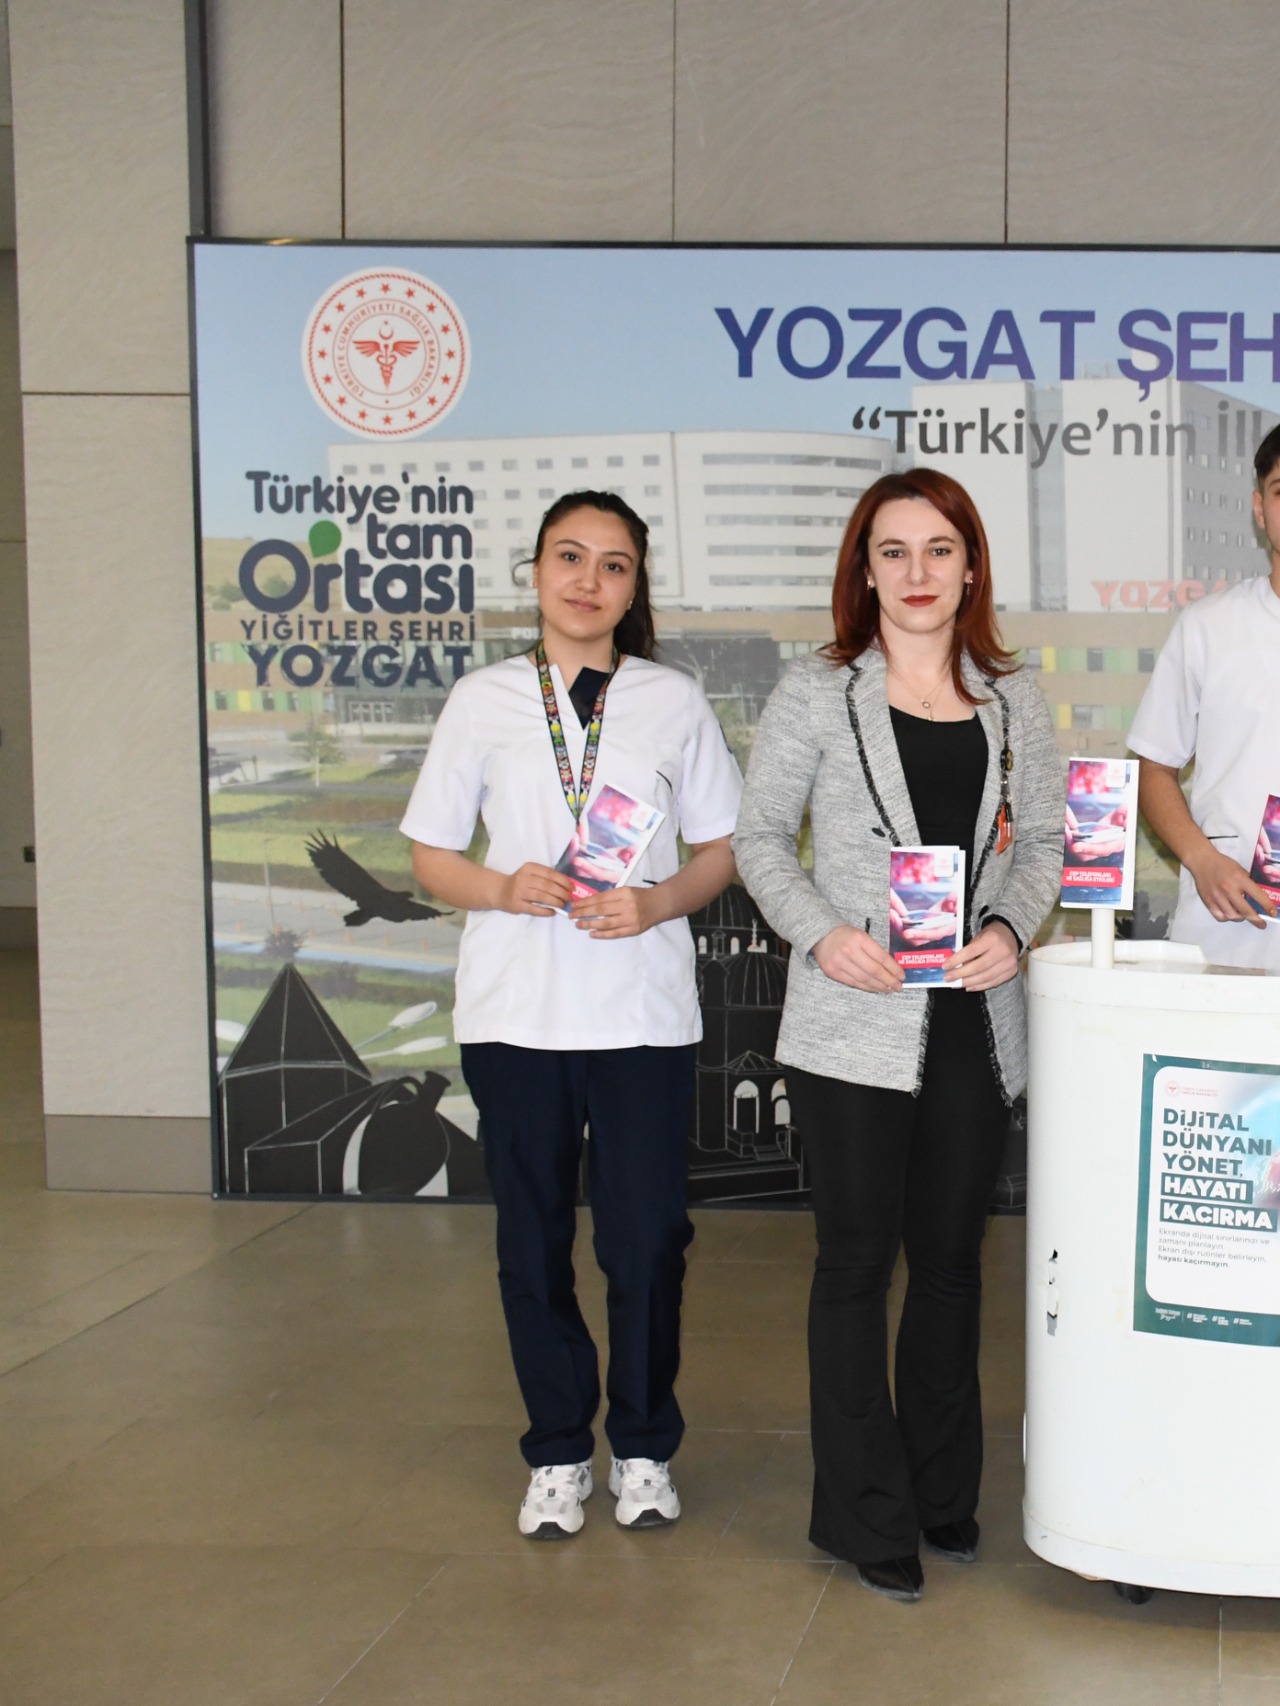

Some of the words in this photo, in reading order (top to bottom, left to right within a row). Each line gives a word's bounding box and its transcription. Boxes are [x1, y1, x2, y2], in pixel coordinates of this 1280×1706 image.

[714, 306, 1095, 380] YOZGAT
[366, 512, 473, 560] tam
[239, 539, 475, 615] Ortası
[241, 614, 377, 642] YİĞİTLER
[388, 615, 475, 648] ŞEHRİ
[242, 644, 473, 688] YOZGAT
[1162, 1127, 1272, 1156] DÜNYANI
[1162, 1151, 1244, 1177] YÖNET,
[1164, 1176, 1247, 1201] HAYATI
[1163, 1202, 1273, 1230] KAÇIRMA
[1158, 1238, 1186, 1246] zamanı
[1159, 1228, 1190, 1237] Ekranda
[1158, 1245, 1180, 1253] Ekran
[1158, 1254, 1182, 1263] hayatı
